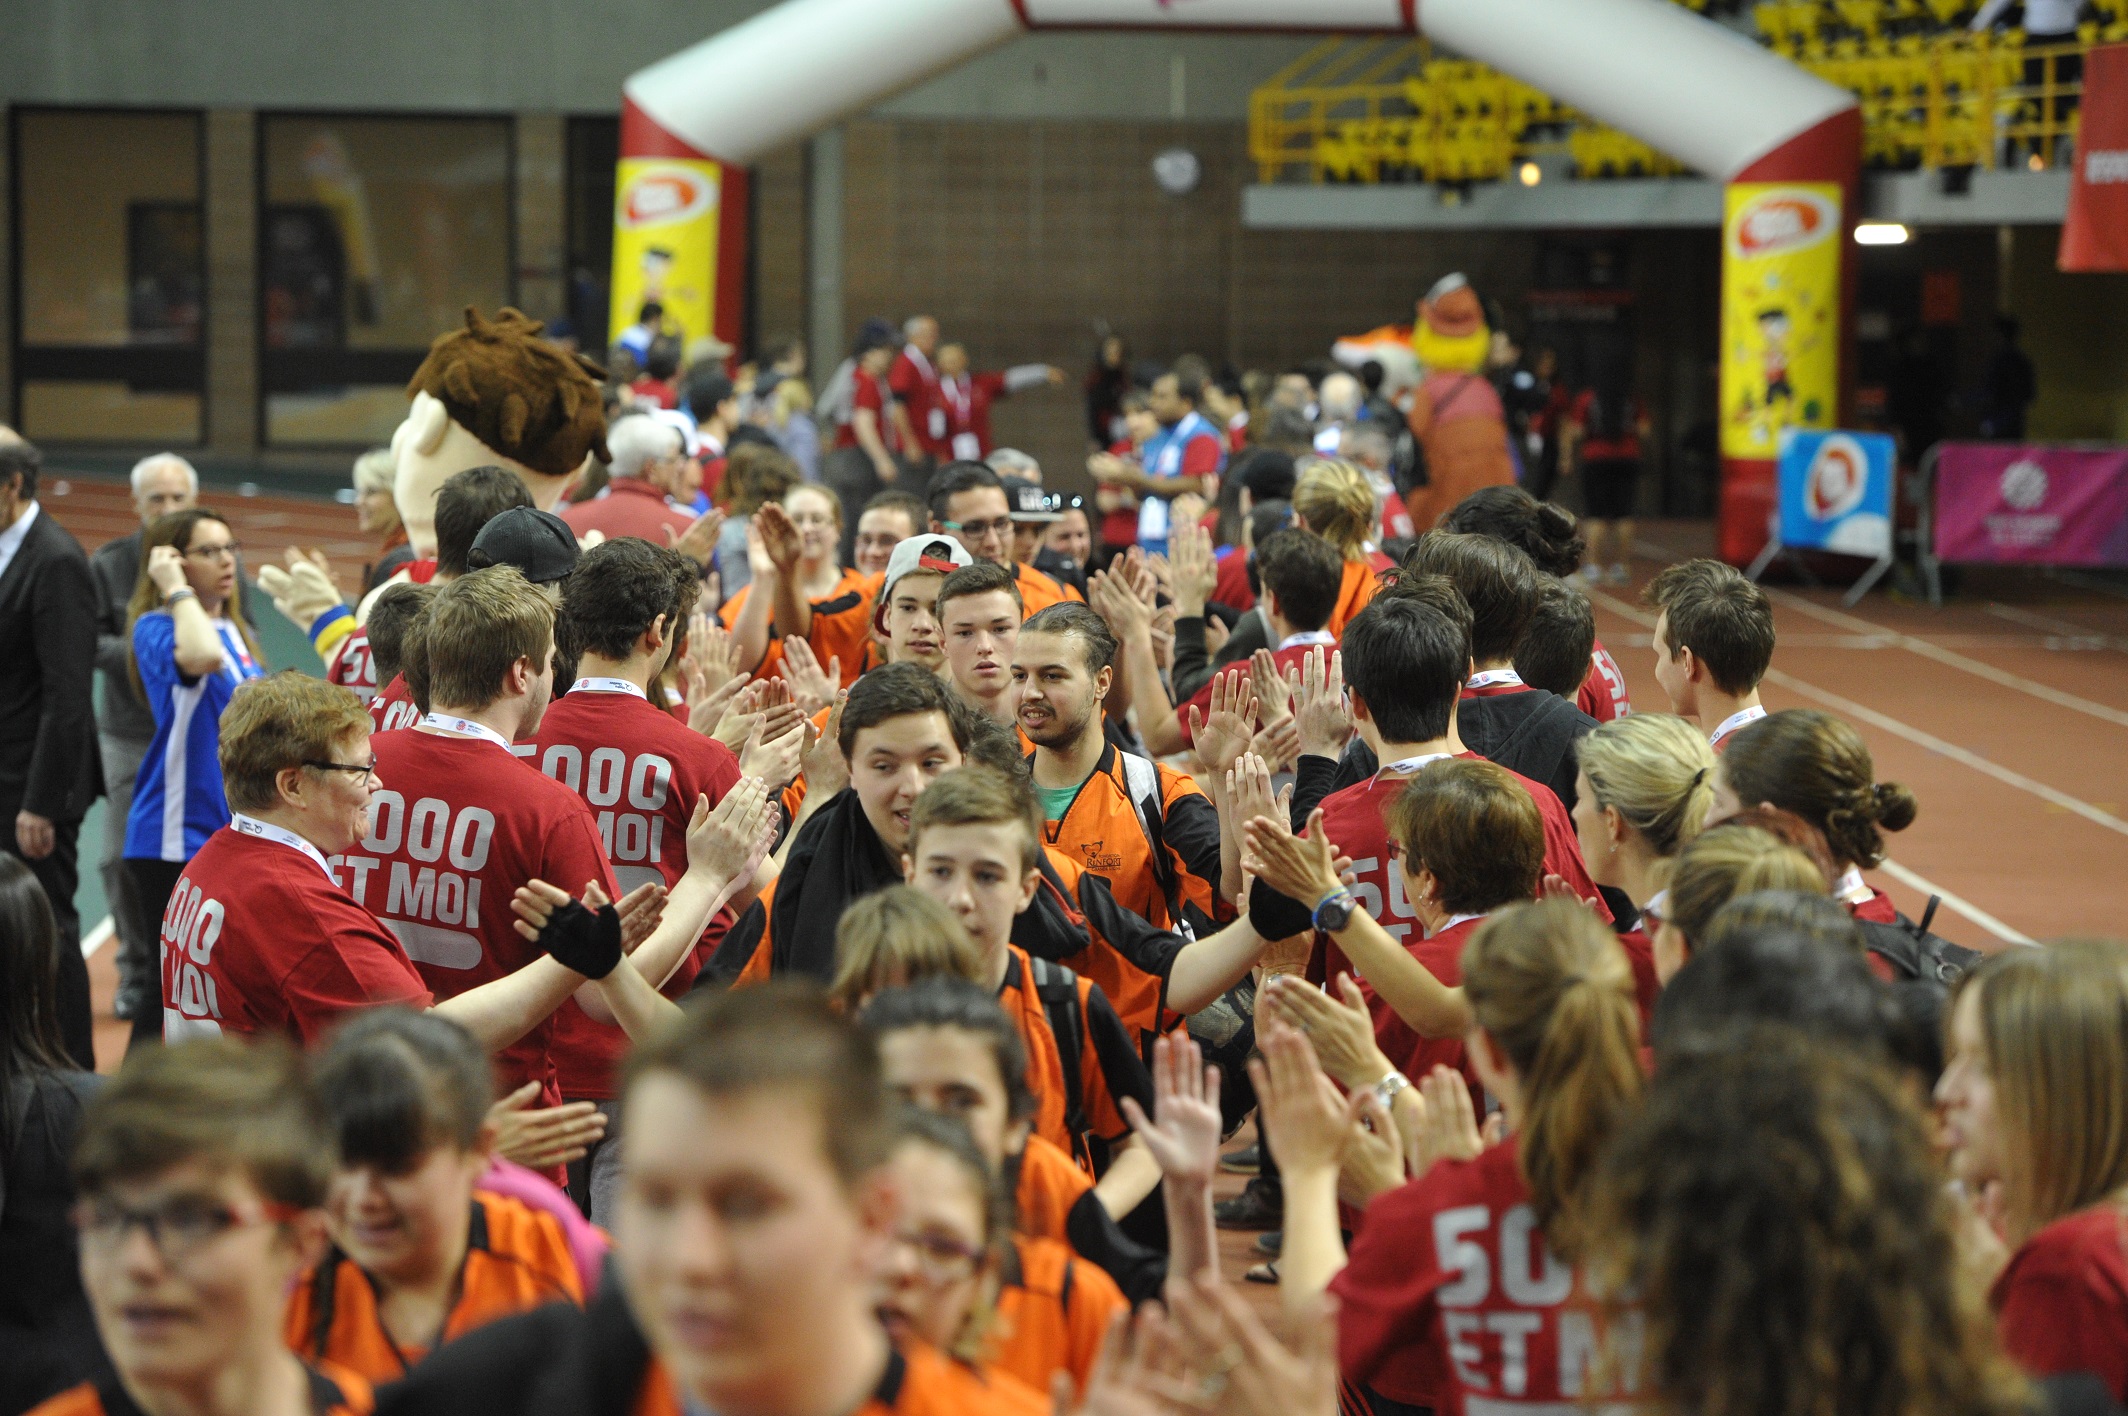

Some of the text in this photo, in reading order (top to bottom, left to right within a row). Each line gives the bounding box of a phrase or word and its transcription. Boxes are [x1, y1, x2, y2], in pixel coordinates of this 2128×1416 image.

[512, 744, 672, 811] 000
[360, 789, 496, 871] 000
[386, 860, 482, 929] MOI
[1443, 1310, 1543, 1397] ET
